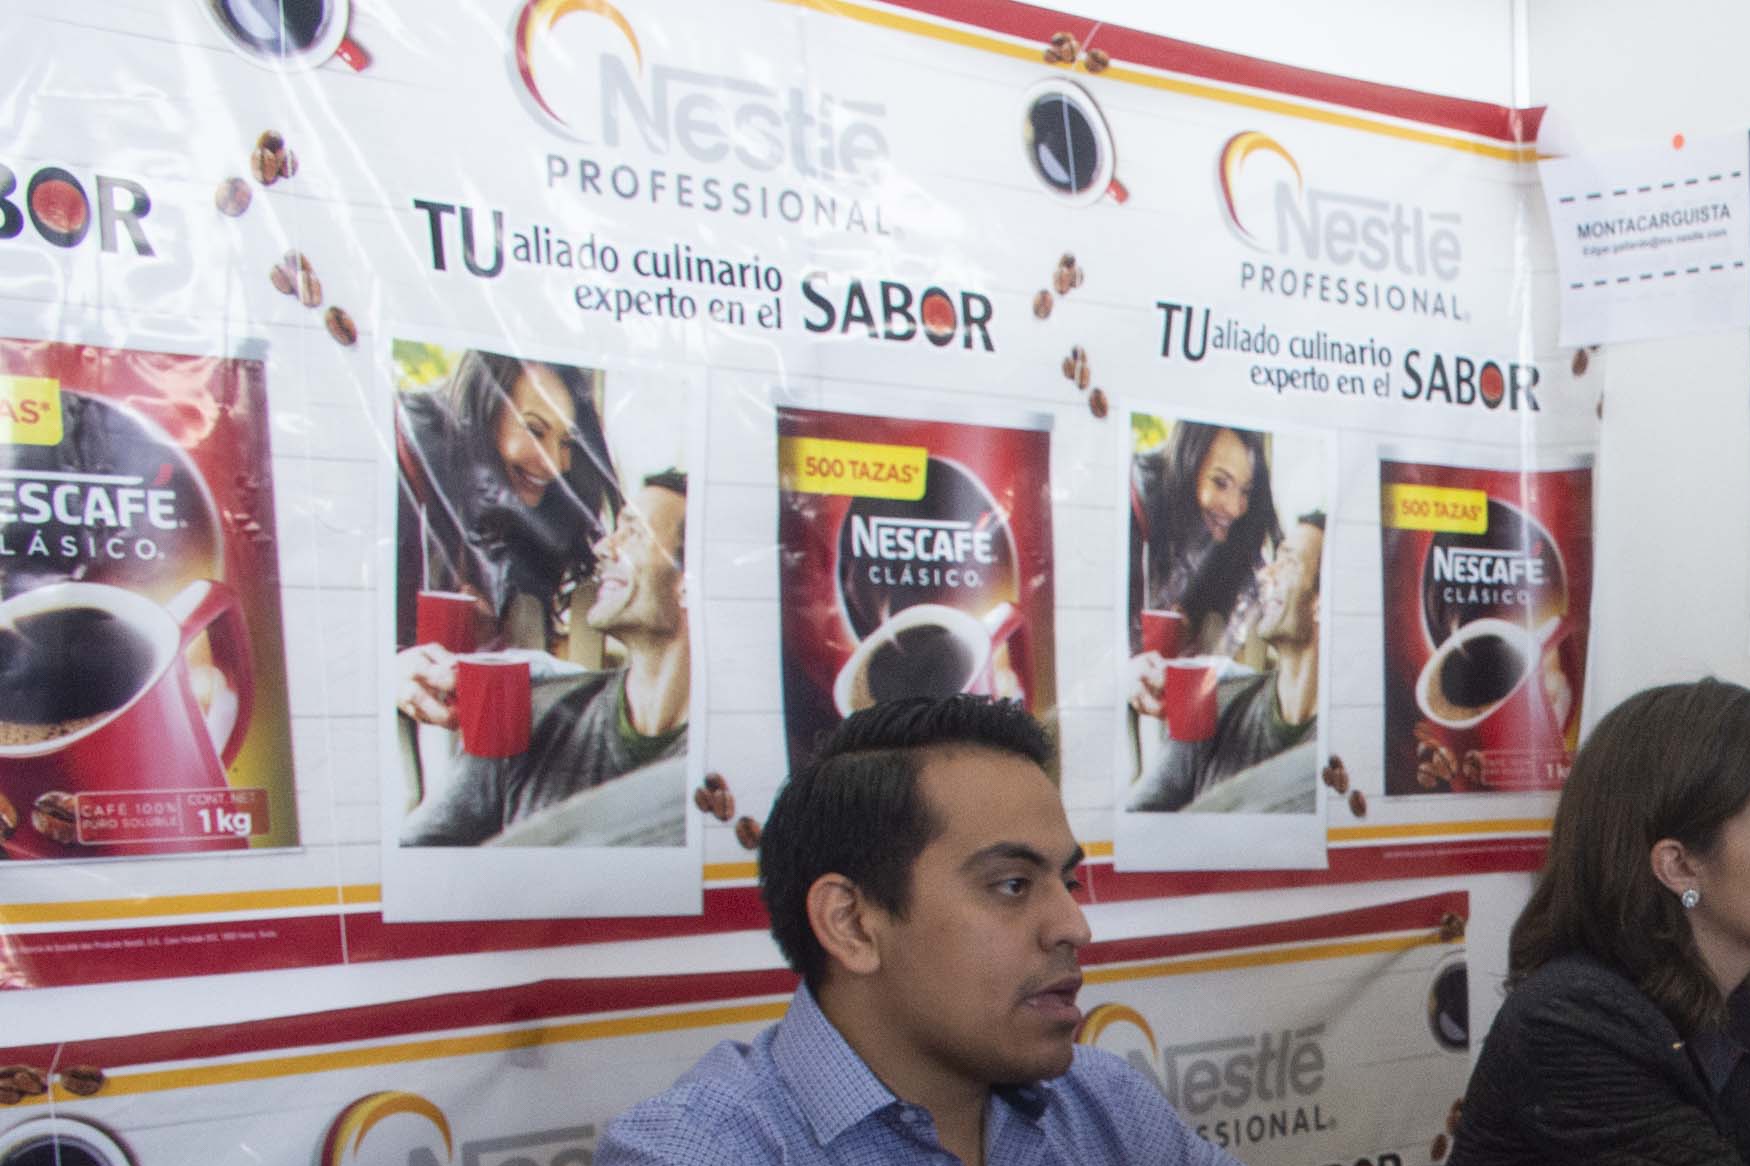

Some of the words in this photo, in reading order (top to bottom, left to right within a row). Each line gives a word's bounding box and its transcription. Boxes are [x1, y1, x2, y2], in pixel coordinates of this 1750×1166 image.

[547, 153, 892, 236] PROFESSIONAL
[1577, 204, 1731, 240] MONTACARGUISTA
[414, 200, 504, 278] TU
[513, 226, 619, 273] aliado
[633, 243, 784, 293] culinario
[575, 283, 696, 322] experto
[708, 298, 745, 326] en
[757, 296, 783, 330] el
[802, 272, 995, 352] SABOR
[1241, 262, 1465, 321] PROFESSIONAL
[1156, 302, 1211, 362] TU
[1212, 319, 1280, 355] aliado
[1289, 331, 1393, 368] culinario
[1250, 364, 1330, 396] experto
[1337, 373, 1365, 395] en
[1373, 371, 1391, 398] el
[1402, 348, 1541, 412] SABOR
[0, 464, 178, 530] ESCAFÉ
[805, 456, 845, 478] 500
[1402, 500, 1429, 518] 500
[0, 529, 158, 560] LÁSICO
[868, 563, 980, 587] CLÁSICO
